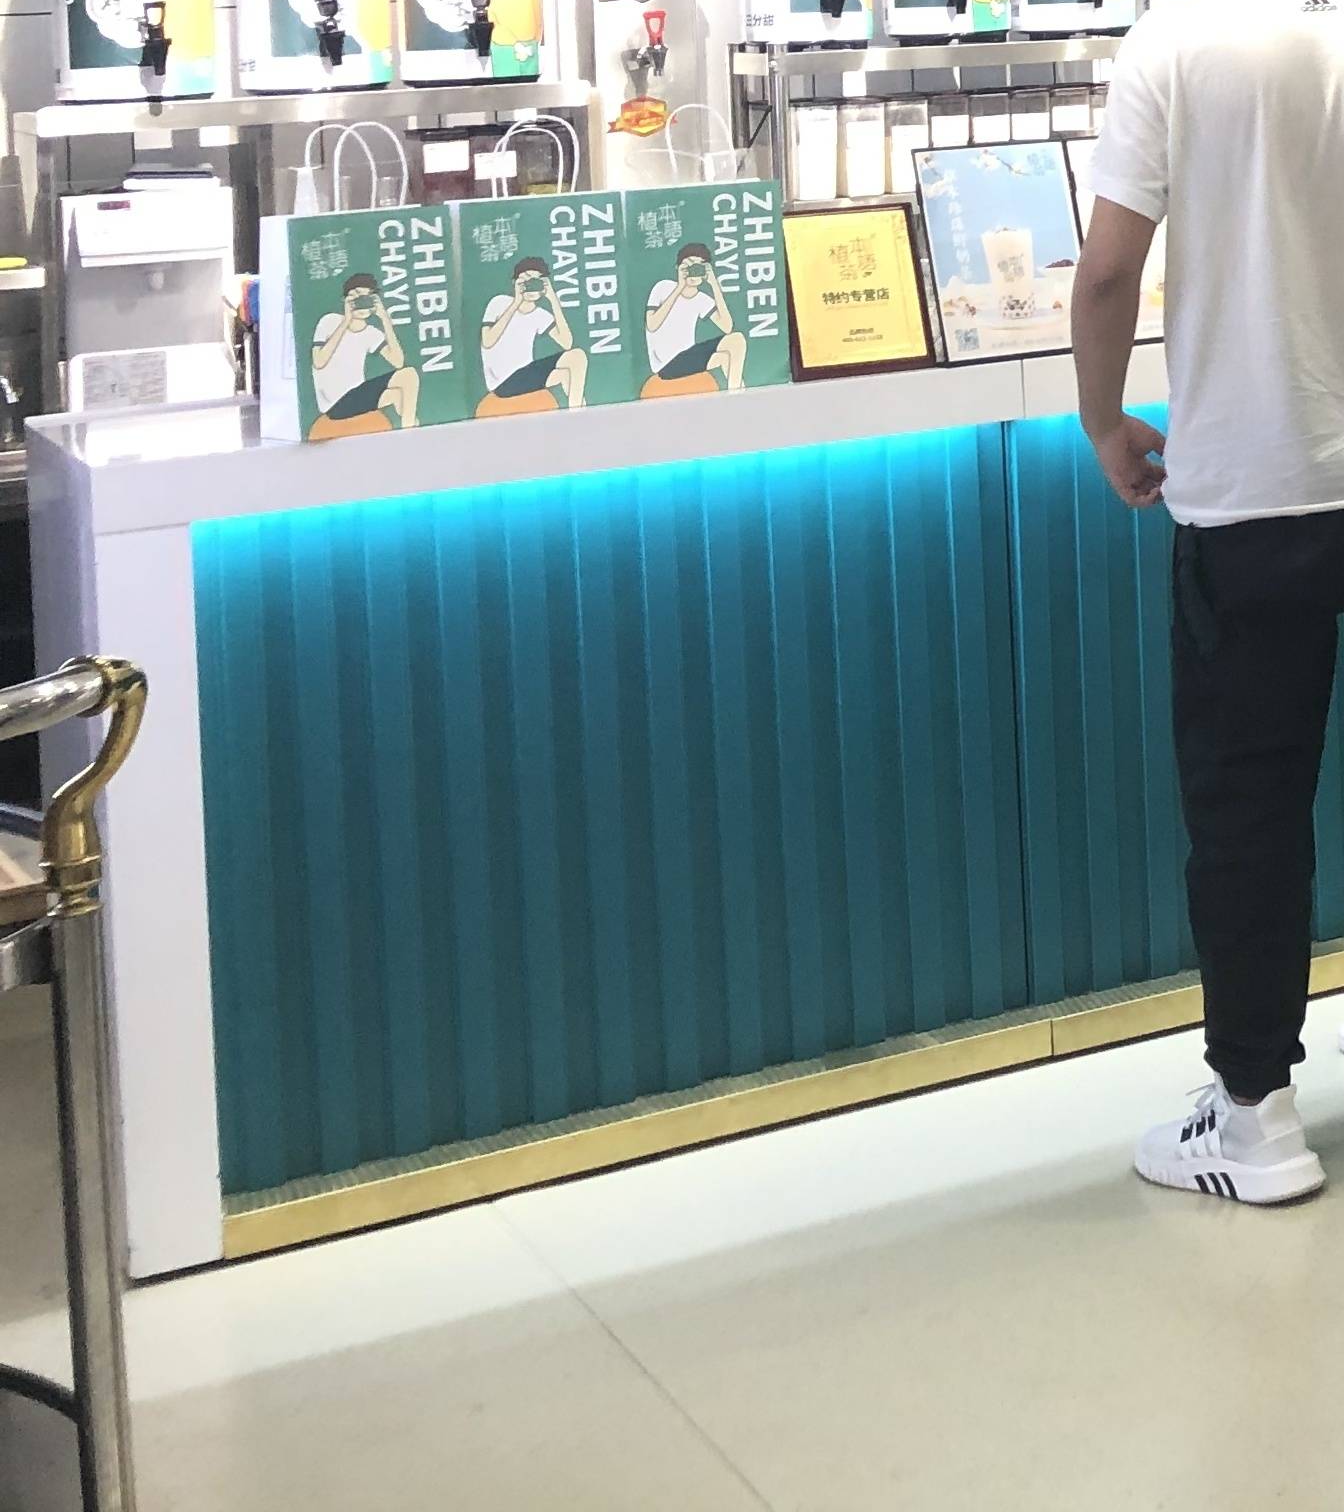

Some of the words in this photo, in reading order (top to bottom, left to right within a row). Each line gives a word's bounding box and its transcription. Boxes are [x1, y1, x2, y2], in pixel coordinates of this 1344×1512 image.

[378, 219, 412, 326] CHAYU
[410, 216, 454, 373] ZHIBEN
[550, 205, 580, 309] CHAYU
[581, 203, 622, 355] ZHIBEN
[712, 192, 740, 294] CHAYU
[743, 190, 779, 338] ZHIBEN
[821, 288, 890, 306] 特约专营店
